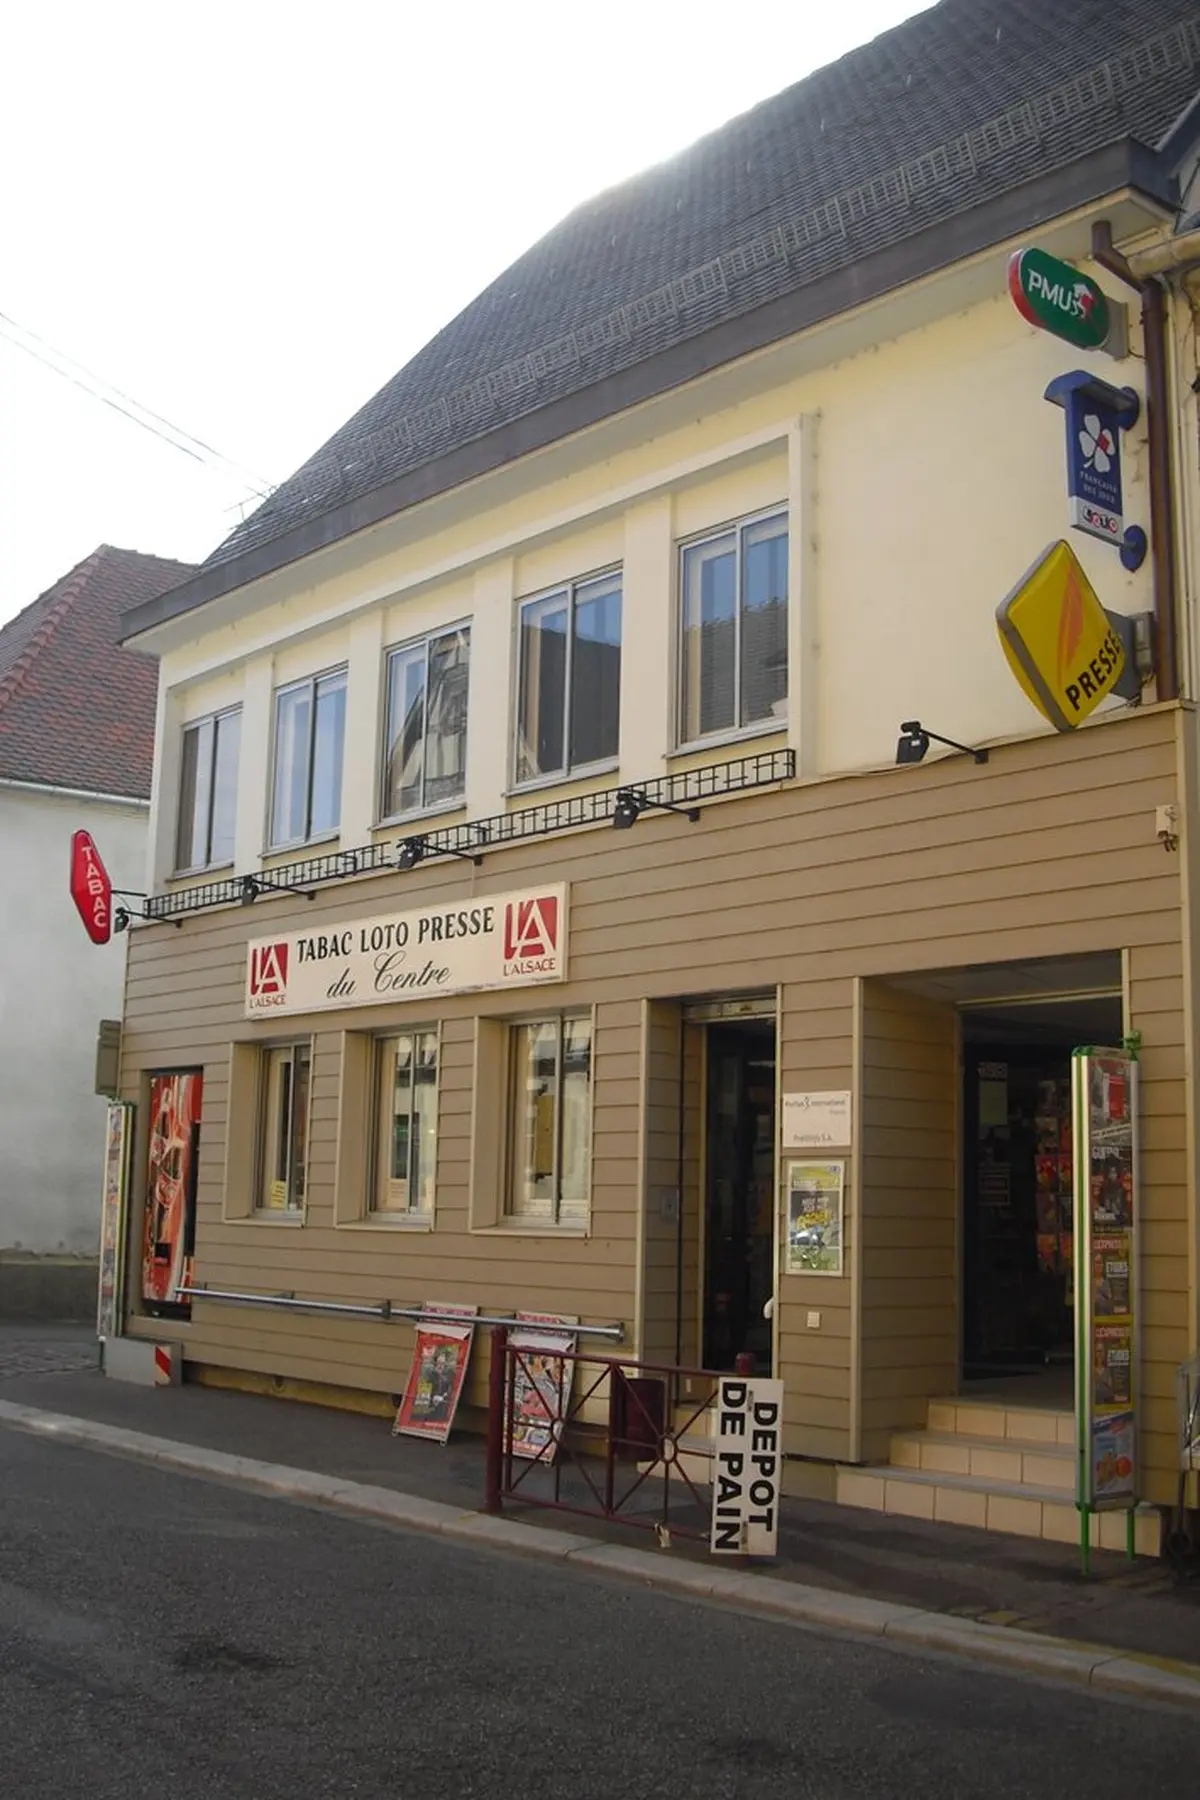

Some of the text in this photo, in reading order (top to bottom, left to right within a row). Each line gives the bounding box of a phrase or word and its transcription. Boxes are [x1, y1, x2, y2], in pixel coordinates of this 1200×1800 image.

[1027, 268, 1072, 311] PMU
[1065, 628, 1123, 711] PRESSE
[81, 846, 107, 928] TABAC
[297, 907, 495, 963] TABAC LOTO PRESSE
[326, 950, 453, 999] du Centre
[503, 957, 556, 977] L'ALSACE
[249, 994, 286, 1009] L'ALSACE
[715, 1382, 747, 1549] DE PAIN
[749, 1402, 778, 1532] DEPOT
